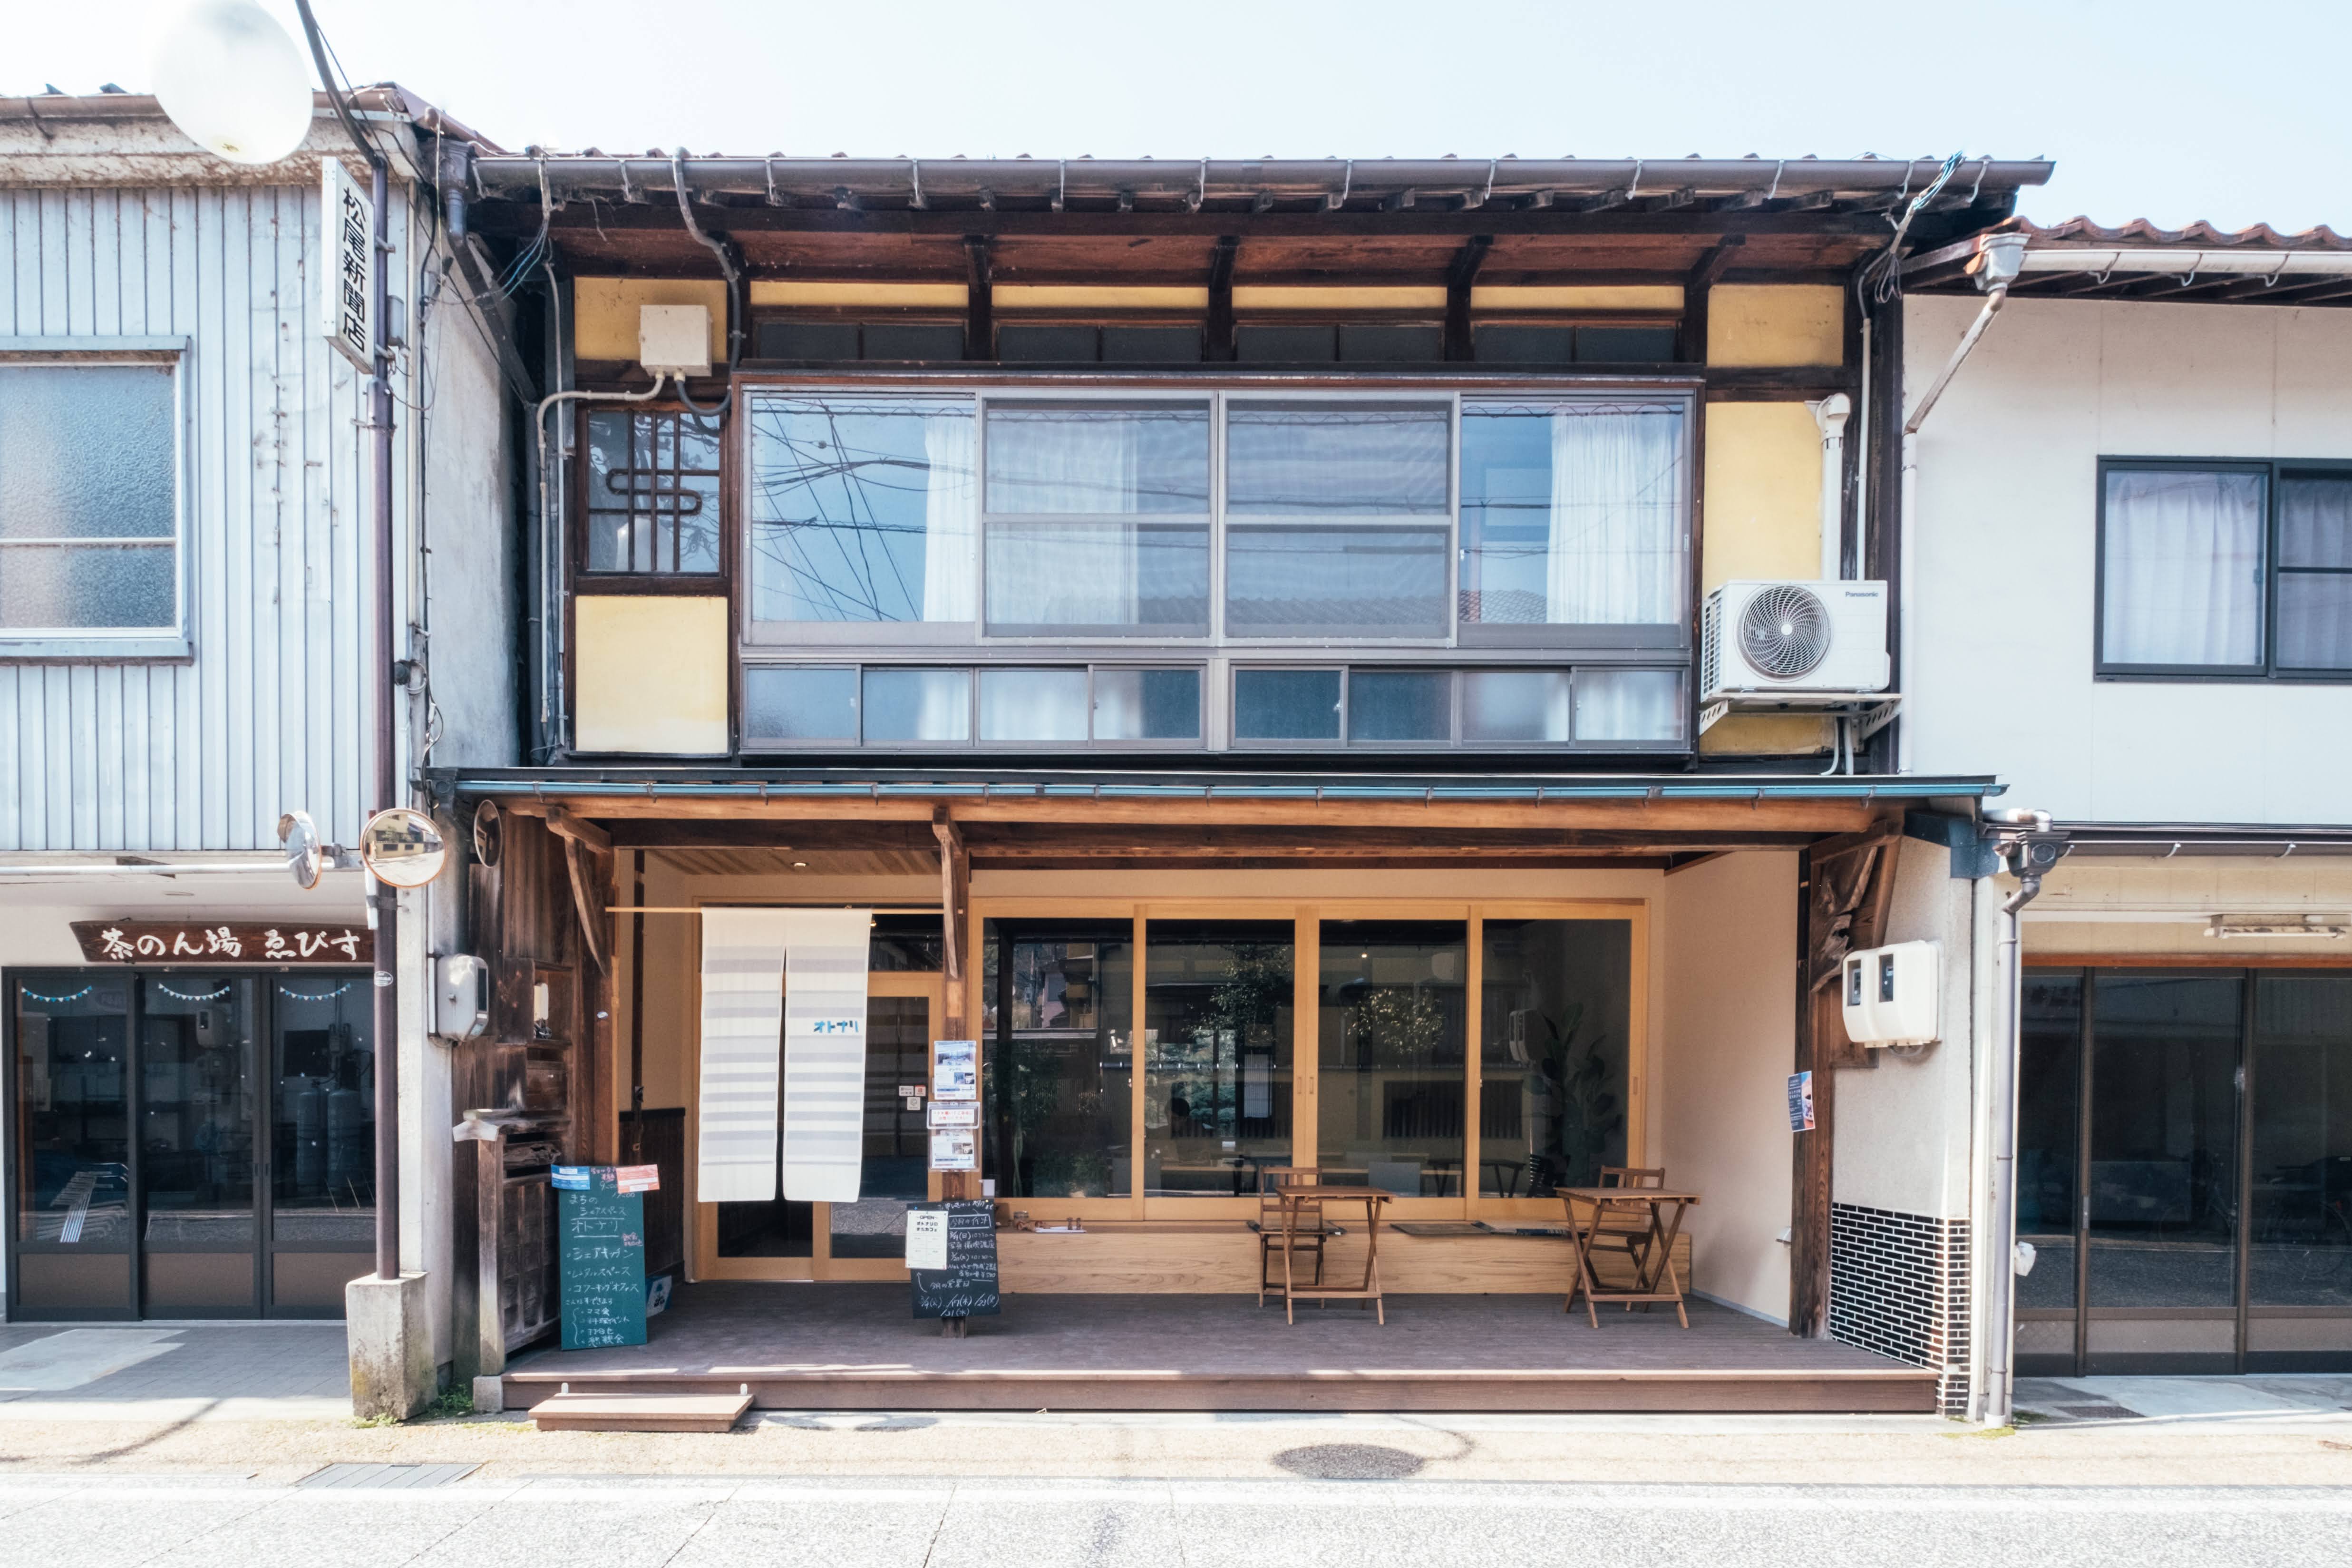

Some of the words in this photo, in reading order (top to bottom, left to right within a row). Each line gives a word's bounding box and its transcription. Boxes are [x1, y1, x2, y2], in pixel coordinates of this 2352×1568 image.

[342, 186, 366, 353] 松尾新聞店
[101, 926, 242, 960] 茶のん場
[264, 928, 360, 961] ゑびす
[813, 1020, 859, 1033] オトナリ
[569, 1194, 598, 1205] まちの
[579, 1206, 628, 1217] シェアスペース
[571, 1220, 618, 1233] オトナリ
